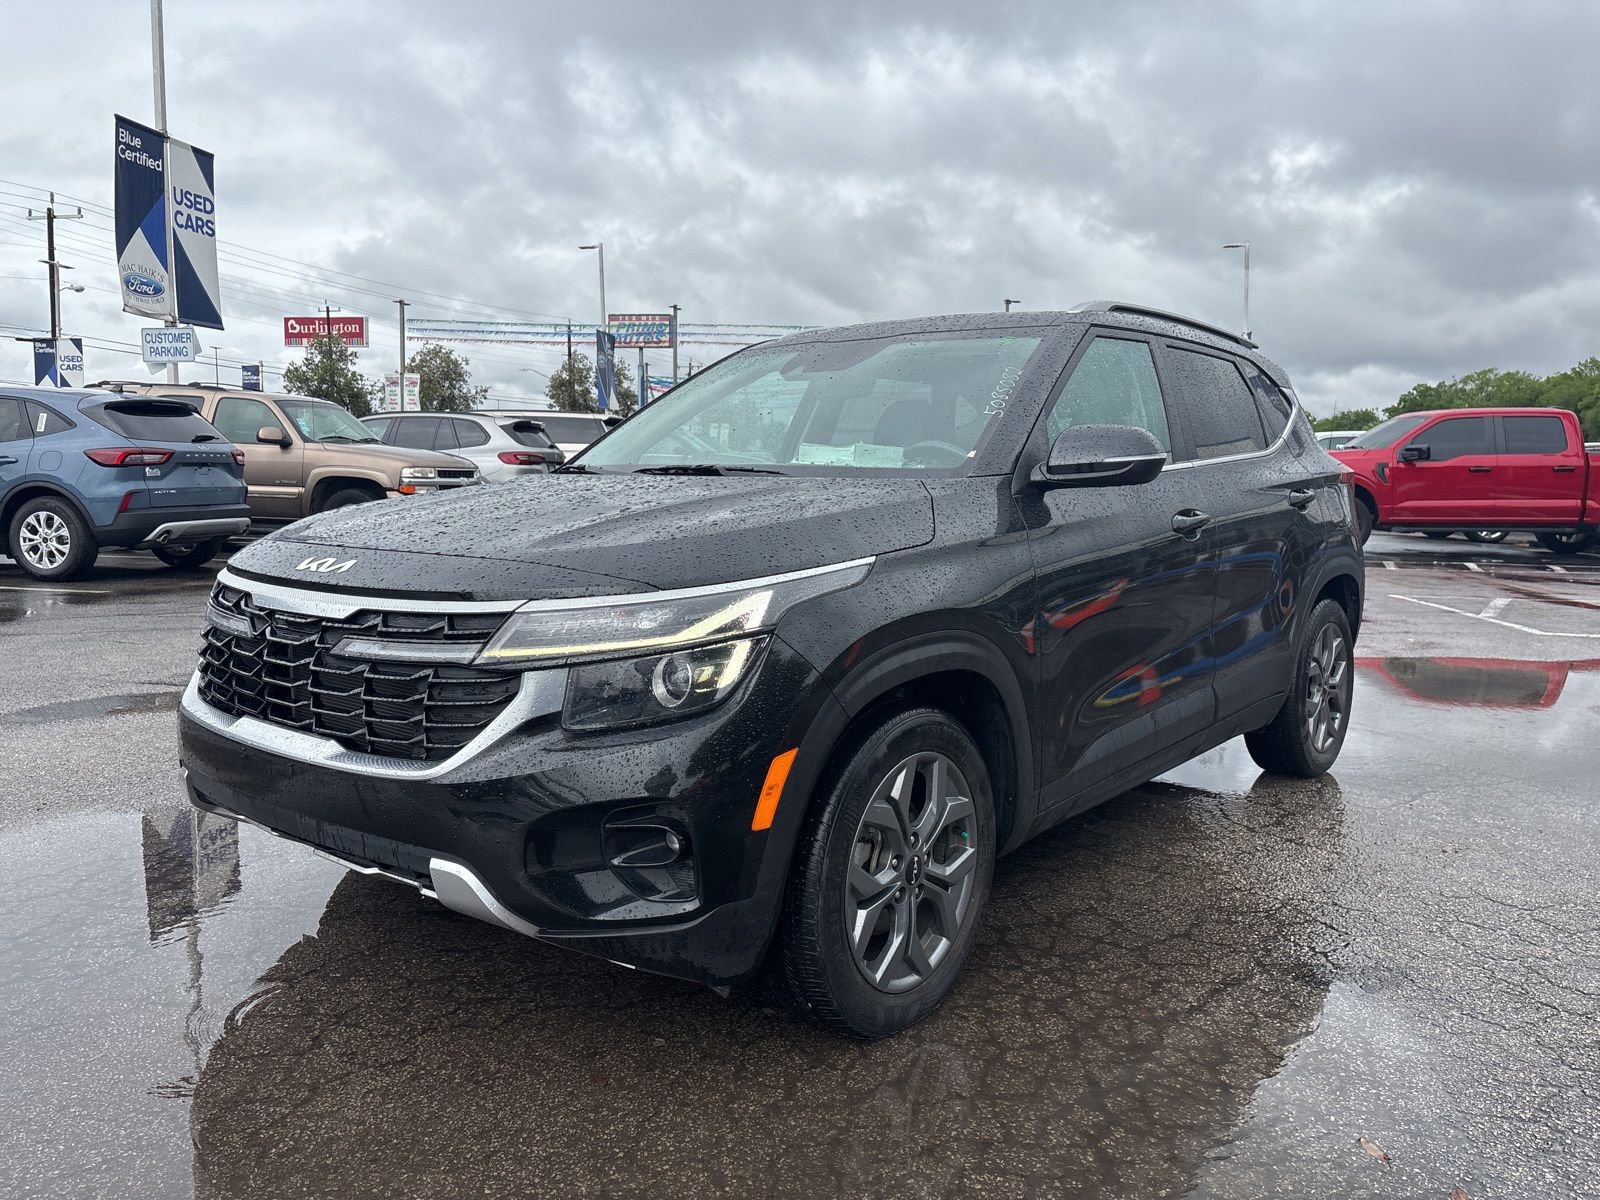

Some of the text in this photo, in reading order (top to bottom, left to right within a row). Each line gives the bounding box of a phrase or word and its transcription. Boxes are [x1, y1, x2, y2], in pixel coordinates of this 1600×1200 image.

[118, 127, 142, 148] Blue
[118, 144, 163, 172] Certified
[173, 185, 215, 215] USED
[174, 209, 216, 238] CARS
[121, 263, 136, 273] MAC
[128, 275, 155, 295] Ford
[144, 332, 192, 344] CUSTOMER
[60, 355, 83, 363] USED
[149, 346, 189, 357] PARKING
[60, 363, 83, 372] CARS
